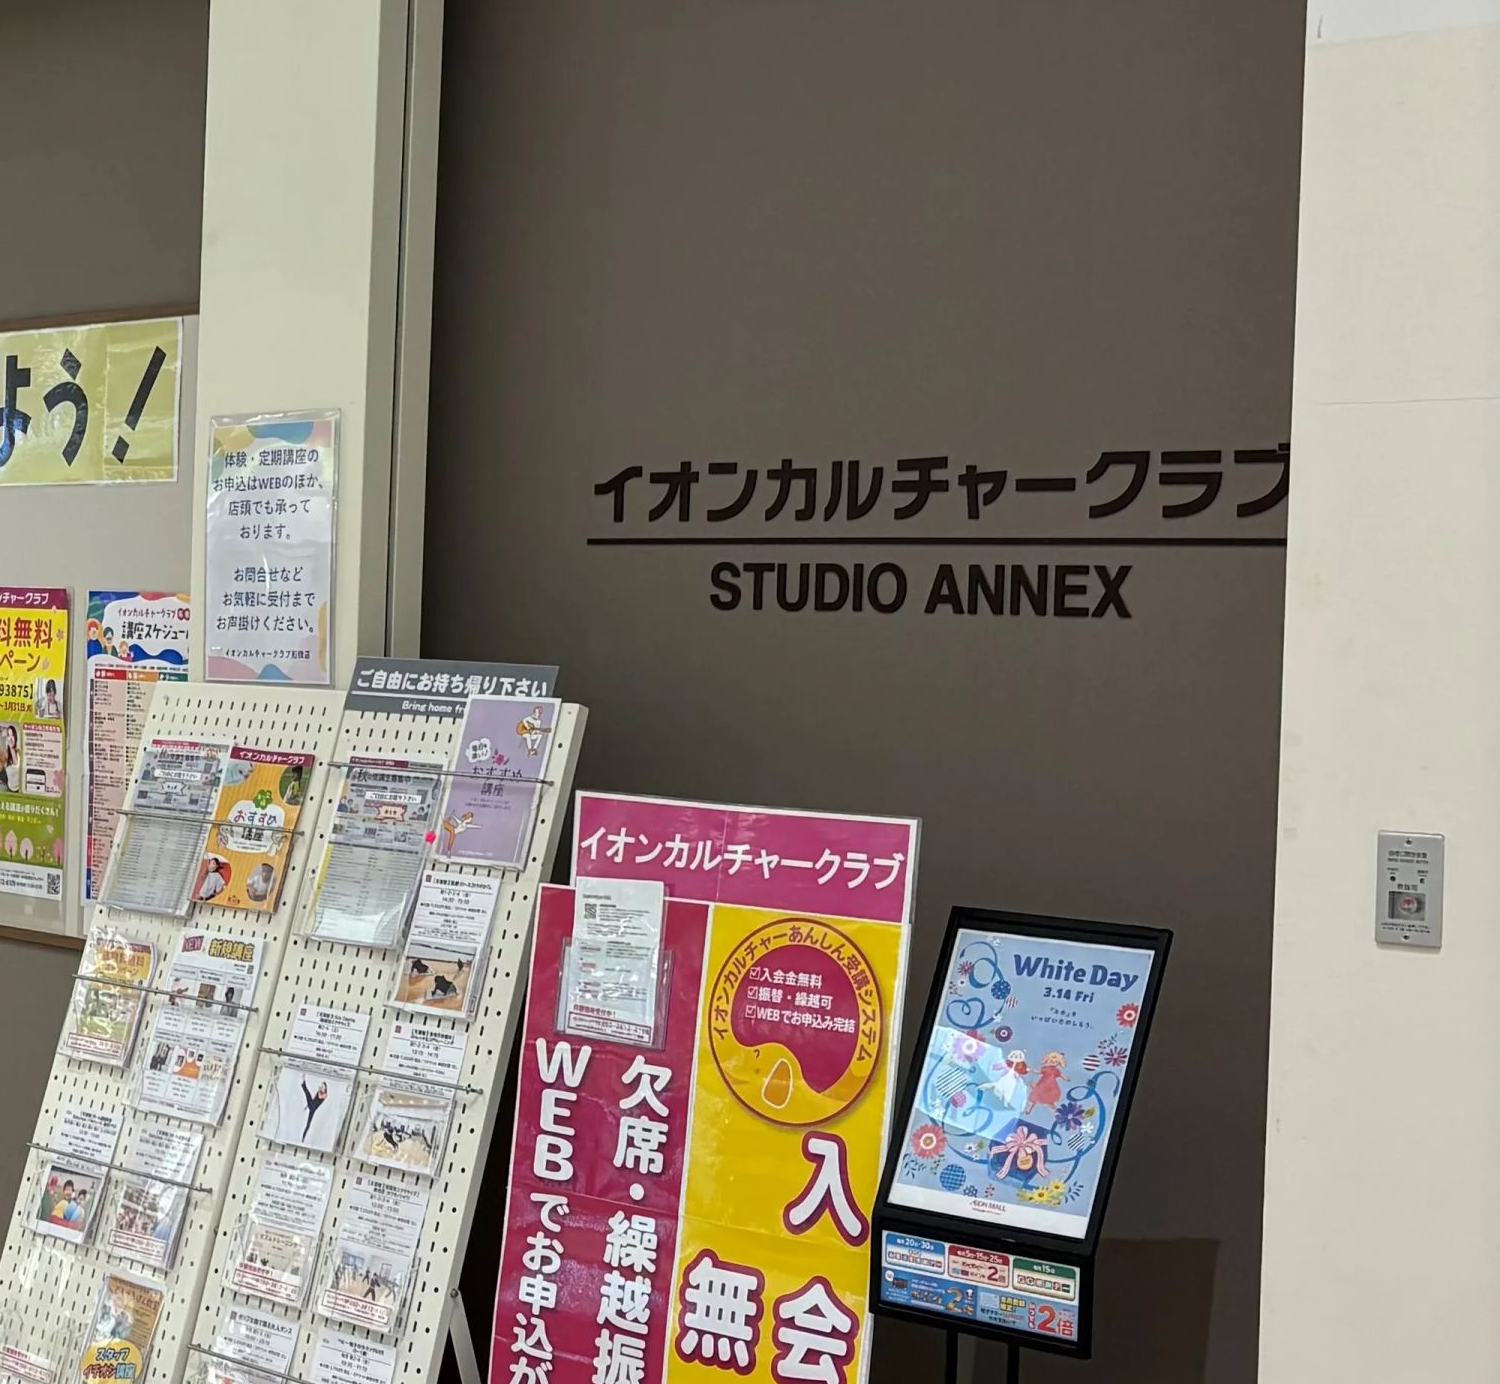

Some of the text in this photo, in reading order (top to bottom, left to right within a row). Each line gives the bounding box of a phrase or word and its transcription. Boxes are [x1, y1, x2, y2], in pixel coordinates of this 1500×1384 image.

[224, 449, 319, 468] 体験・定期講座の
[213, 474, 325, 492] お申込はWEBのほか、
[594, 443, 1290, 523] イオンカルチャークラブ
[228, 499, 311, 516] 店頭でも承って
[239, 524, 292, 540] おります。
[234, 567, 303, 583] お問合せなど
[709, 562, 1134, 618] STUDIO ANNEX
[223, 592, 315, 608] お気軽に受付まで
[217, 615, 315, 633] お声掛けください。
[357, 668, 548, 698] ご自由にお持ち帰り下さい
[402, 700, 427, 713] Bring
[428, 702, 452, 713] home
[580, 827, 906, 891] イオンカルチャークラブ
[760, 968, 822, 989] 入会金無料
[1014, 954, 1139, 992] White Day
[758, 988, 833, 1010] 振替・繰越可
[1043, 987, 1094, 1003] 3.14 Fri
